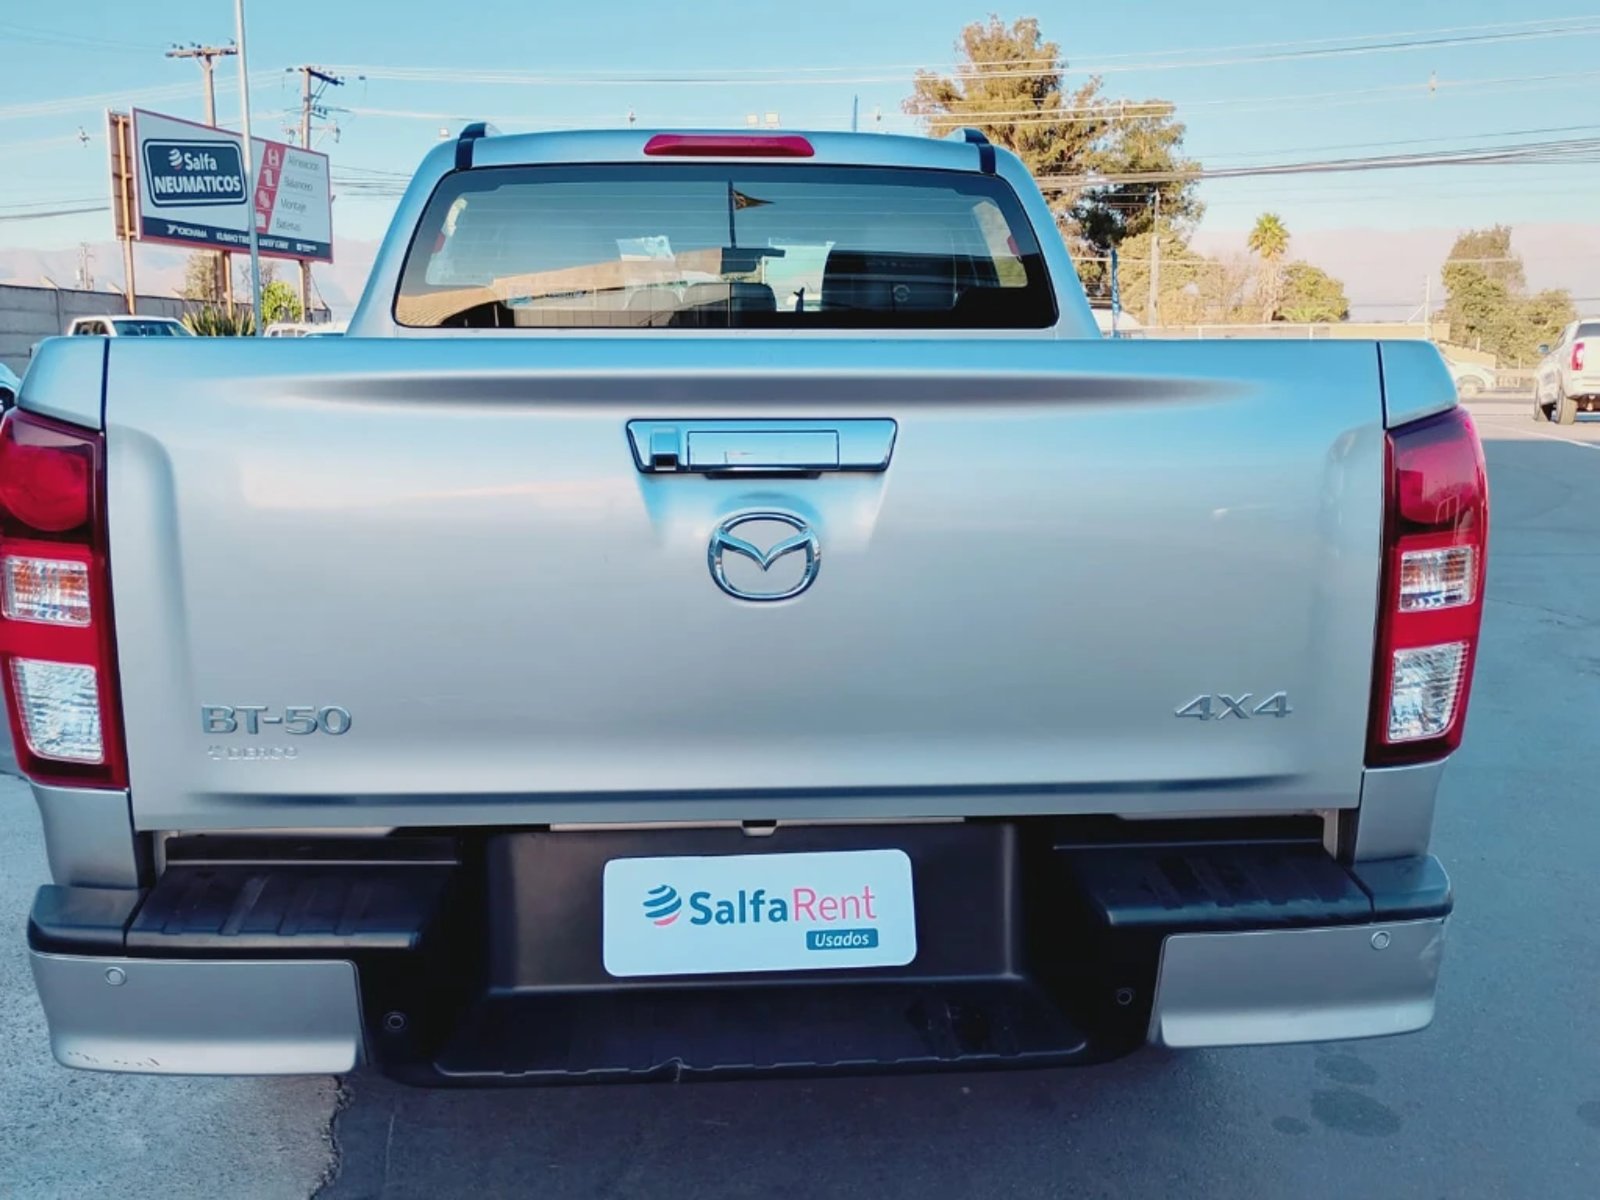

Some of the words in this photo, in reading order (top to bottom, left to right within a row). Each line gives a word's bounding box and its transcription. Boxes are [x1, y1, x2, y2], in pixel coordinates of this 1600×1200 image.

[184, 153, 217, 171] Salfa
[154, 175, 241, 194] NEUMATICOS
[201, 704, 352, 735] BT-50
[814, 932, 870, 948] Usados
